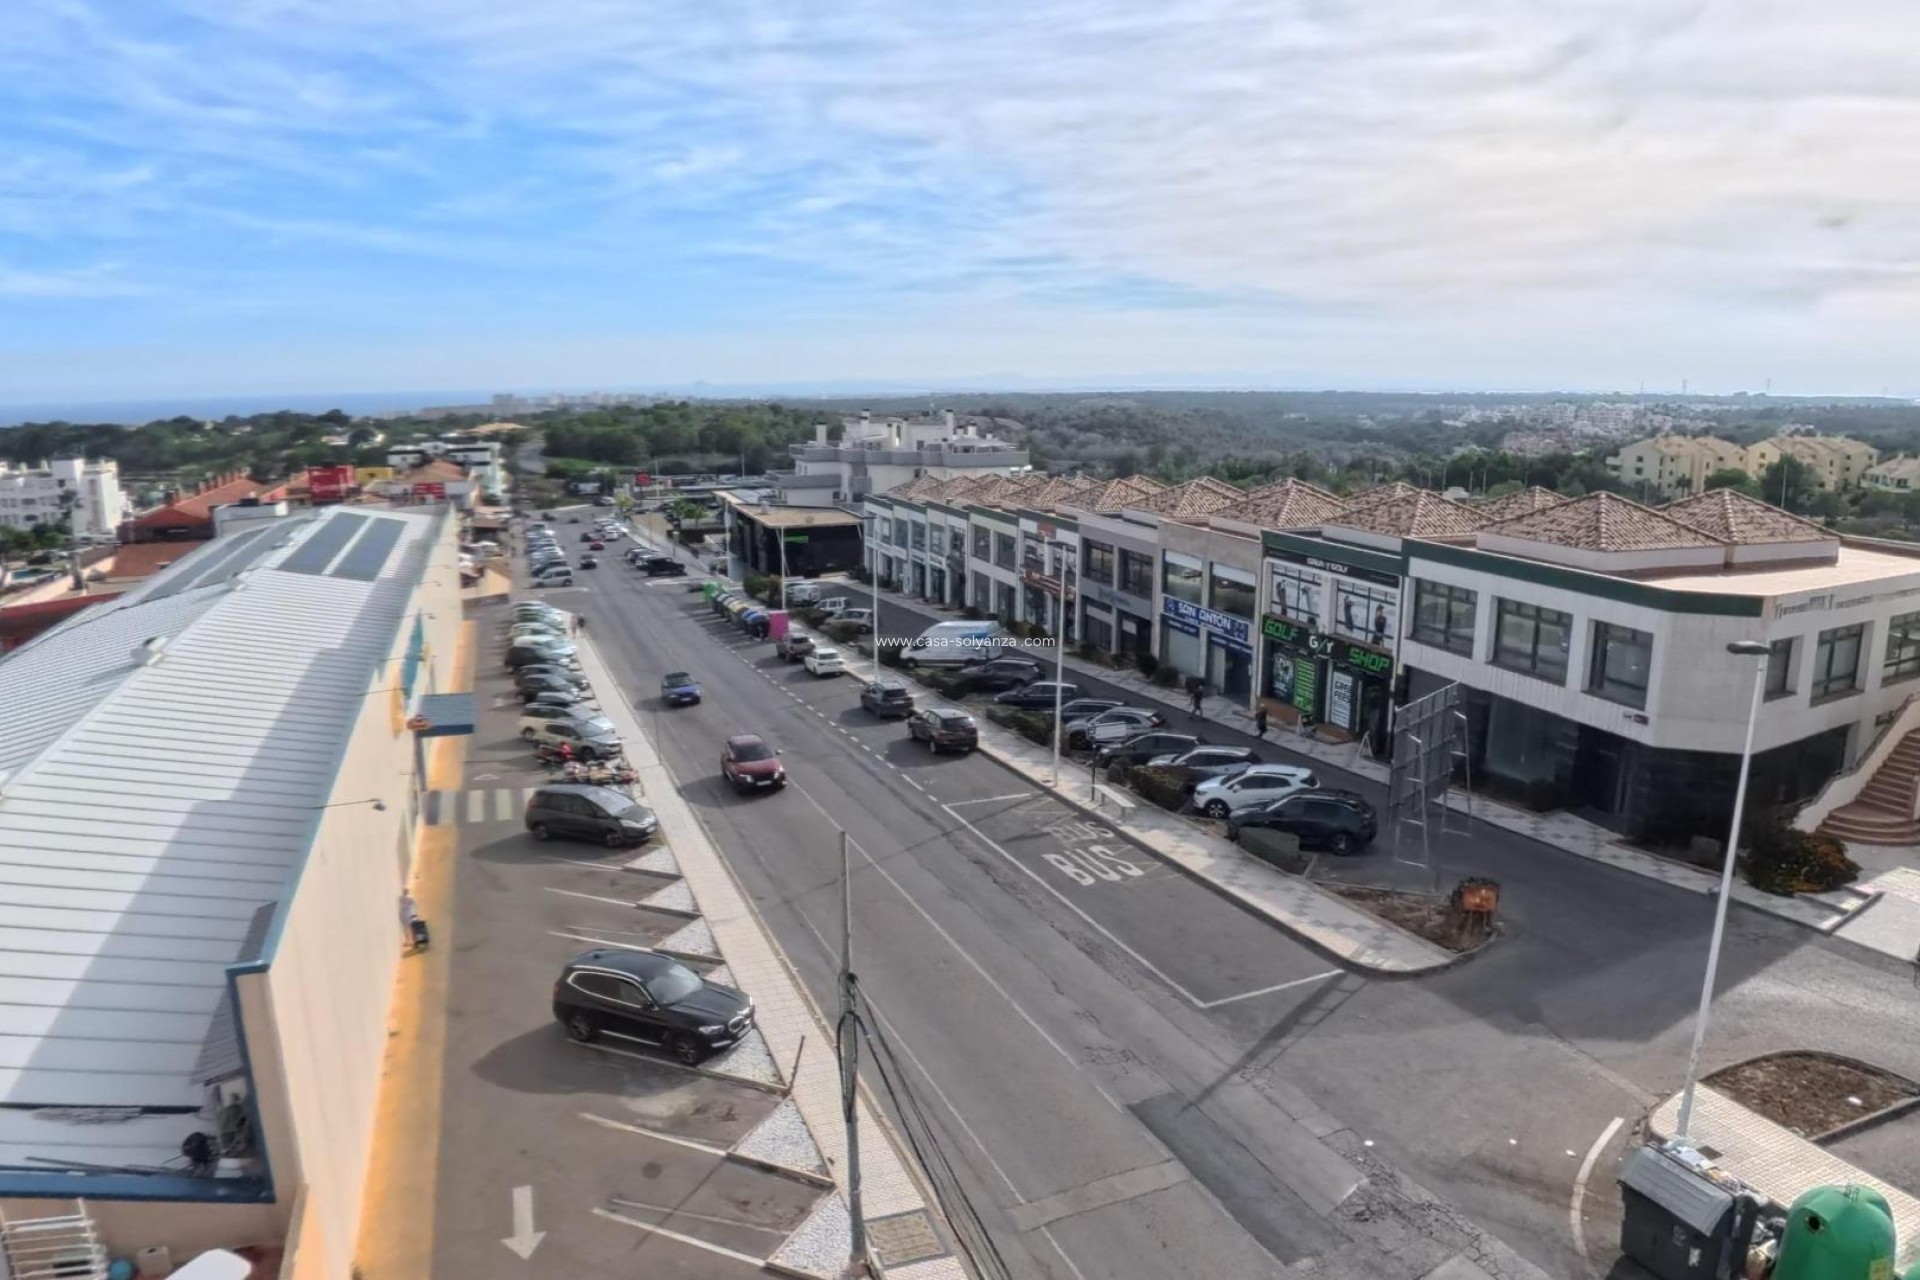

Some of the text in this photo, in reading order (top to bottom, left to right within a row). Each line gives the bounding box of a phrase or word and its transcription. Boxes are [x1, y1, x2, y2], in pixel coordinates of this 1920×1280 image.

[1264, 618, 1299, 641] GOLF
[1349, 647, 1390, 672] SHOP
[1042, 845, 1144, 886] BUS
